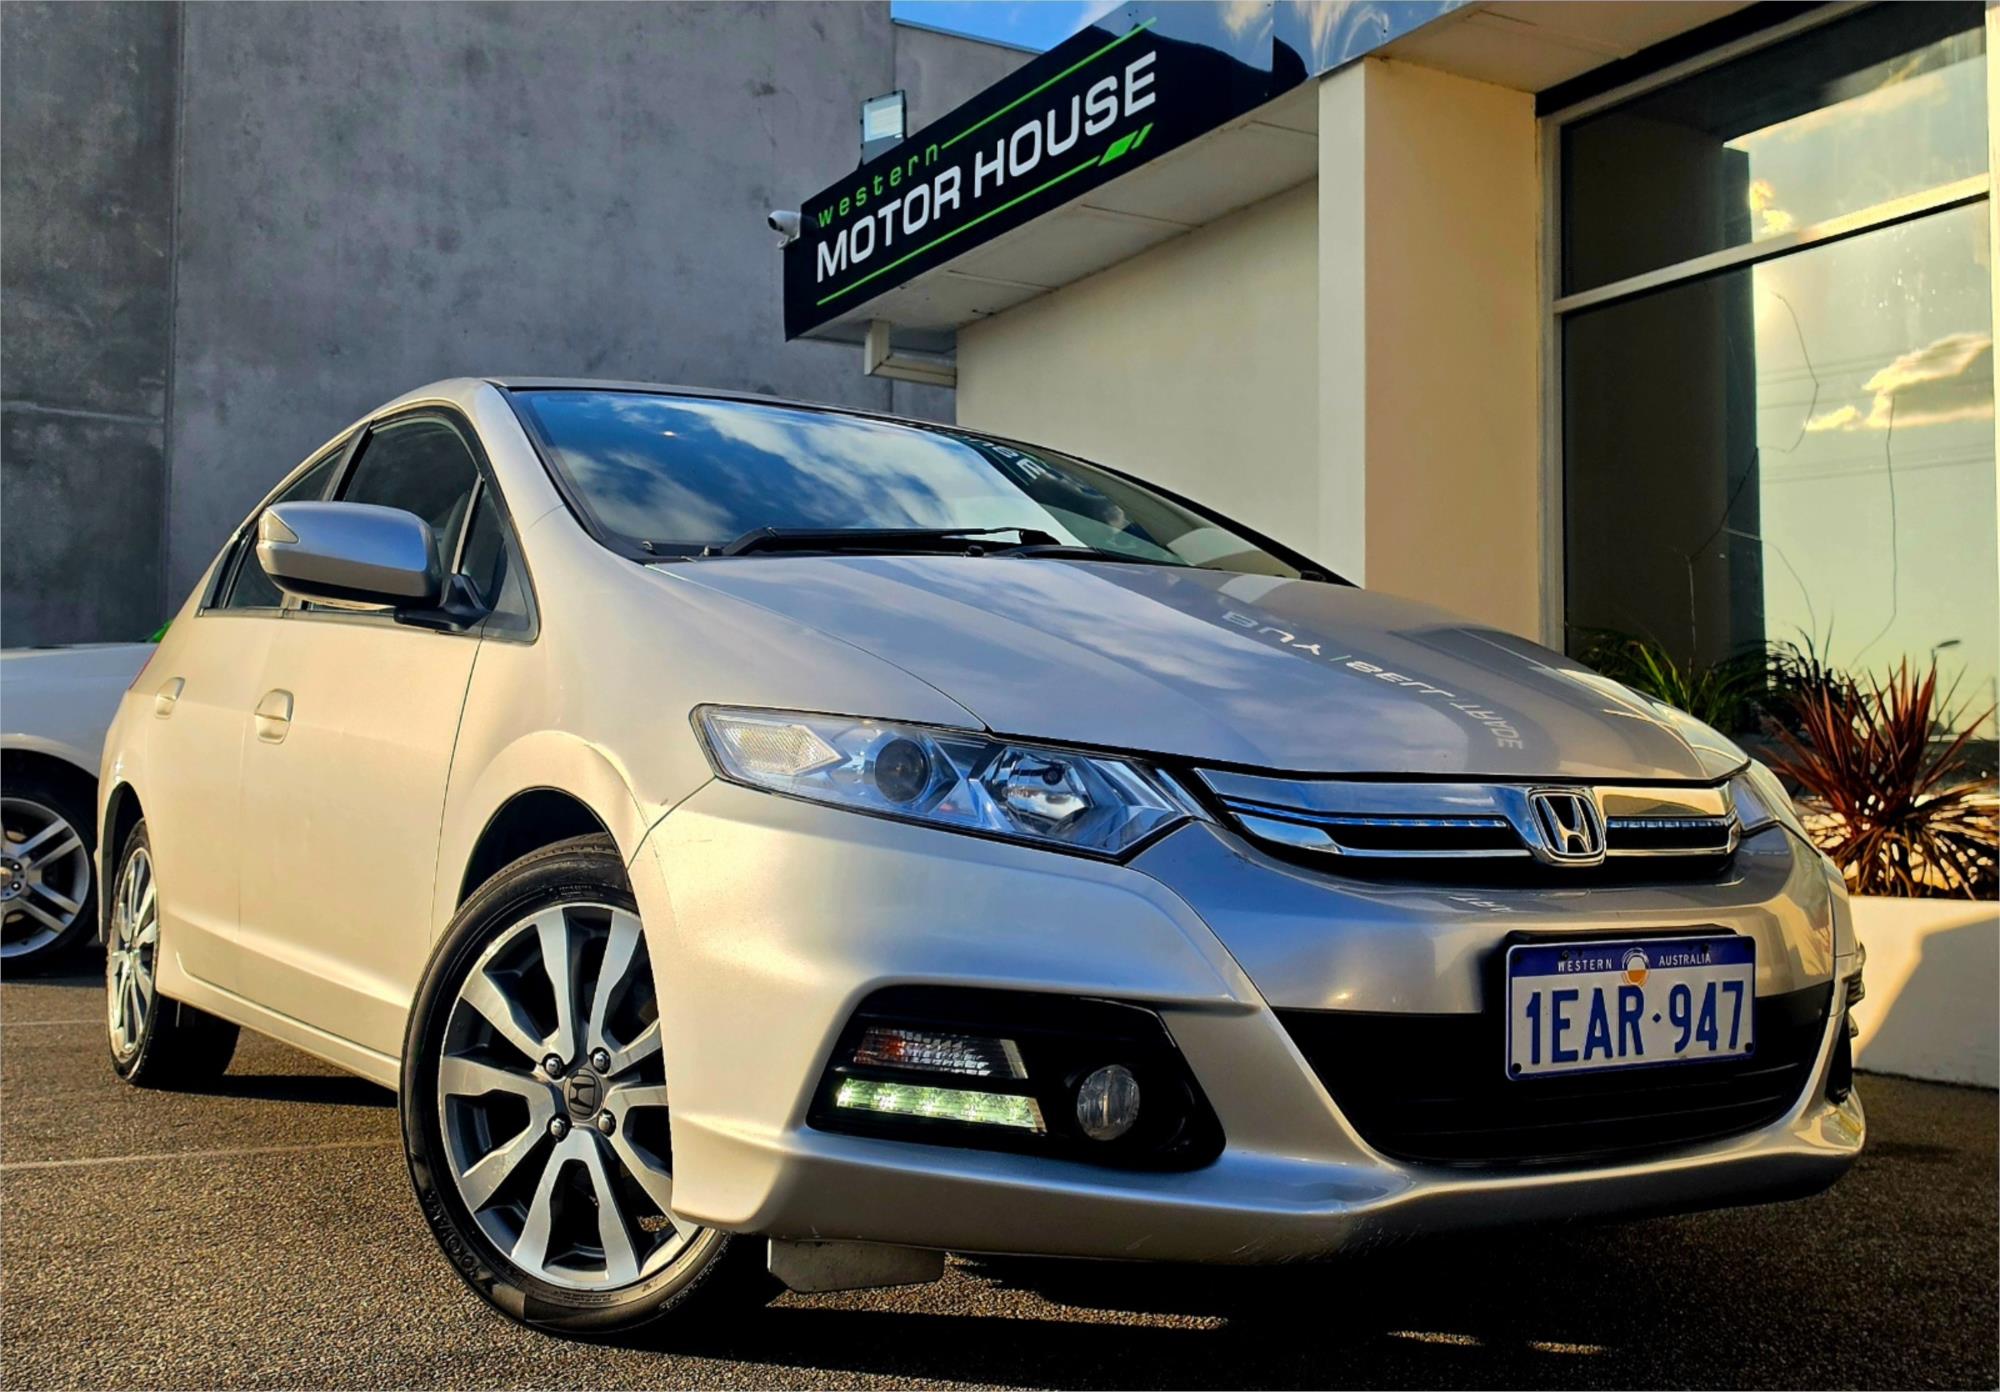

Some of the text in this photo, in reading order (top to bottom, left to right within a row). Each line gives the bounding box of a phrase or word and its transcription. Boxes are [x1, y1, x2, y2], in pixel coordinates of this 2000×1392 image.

[816, 50, 1157, 283] MOTOR HOUSE
[817, 143, 939, 228] western
[1557, 952, 1712, 973] WESTERN AUSTRALIA
